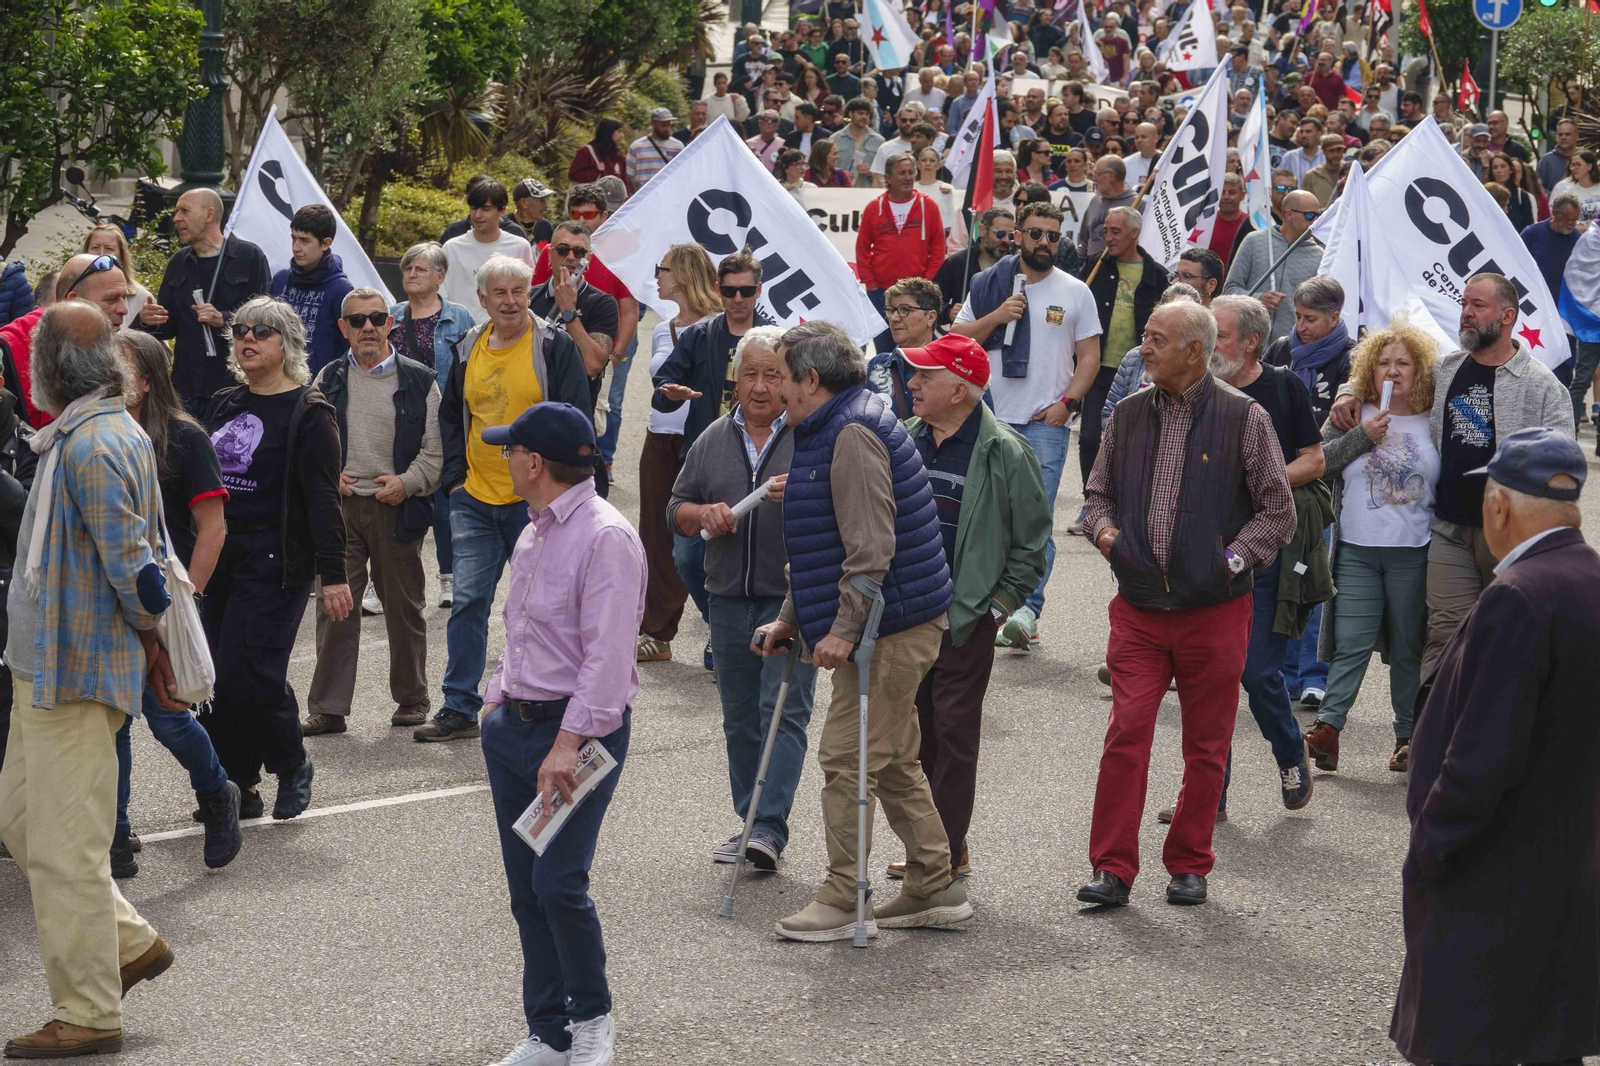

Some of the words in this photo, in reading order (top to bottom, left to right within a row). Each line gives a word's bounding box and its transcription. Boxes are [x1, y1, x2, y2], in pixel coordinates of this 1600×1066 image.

[1159, 180, 1176, 221] Central
[1422, 270, 1438, 288] de
[222, 475, 257, 488] USTRIA
